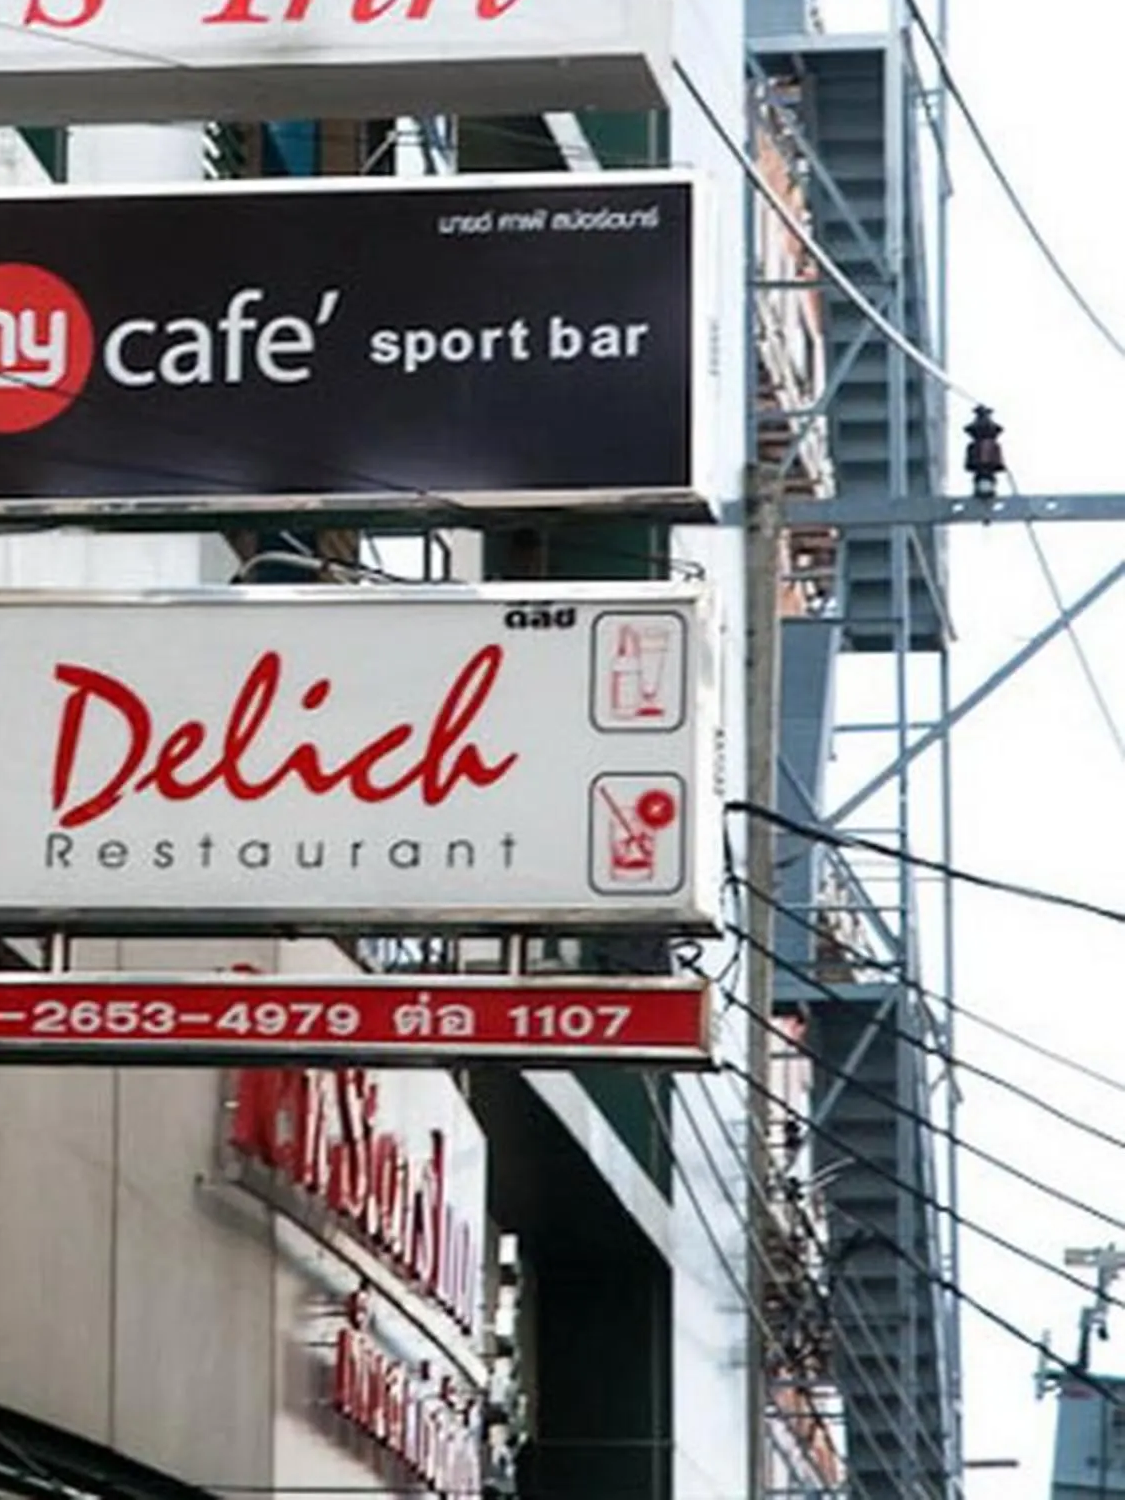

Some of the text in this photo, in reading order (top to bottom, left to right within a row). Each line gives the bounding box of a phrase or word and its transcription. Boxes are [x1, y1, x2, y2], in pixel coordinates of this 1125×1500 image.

[369, 315, 530, 373] sport
[549, 316, 650, 360] bar
[51, 642, 518, 829] Delich
[44, 833, 517, 870] Restaurant
[392, 990, 475, 1037] ต่อ
[507, 1004, 633, 1039] 1107
